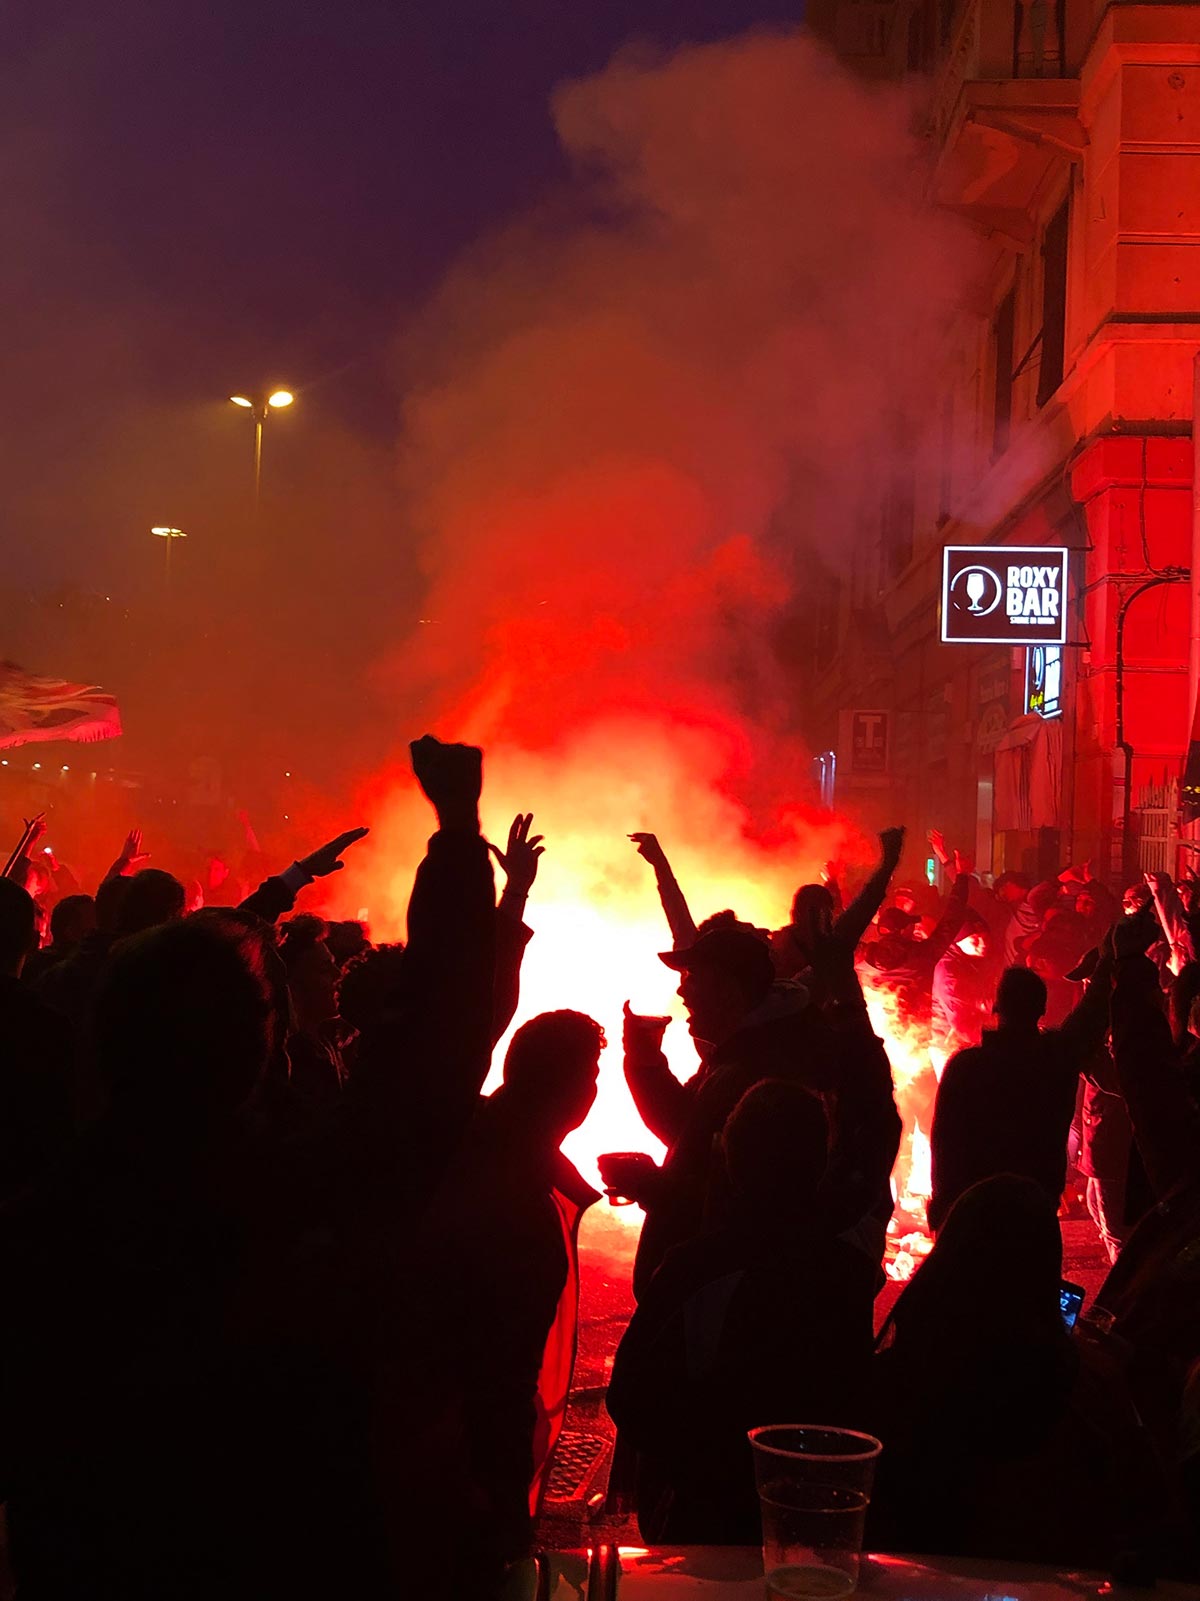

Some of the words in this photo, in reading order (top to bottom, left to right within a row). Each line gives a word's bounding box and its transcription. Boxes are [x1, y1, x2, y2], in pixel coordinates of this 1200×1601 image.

[1007, 566, 1060, 588] ROXY
[1006, 588, 1059, 616] BAR
[859, 715, 881, 748] T
